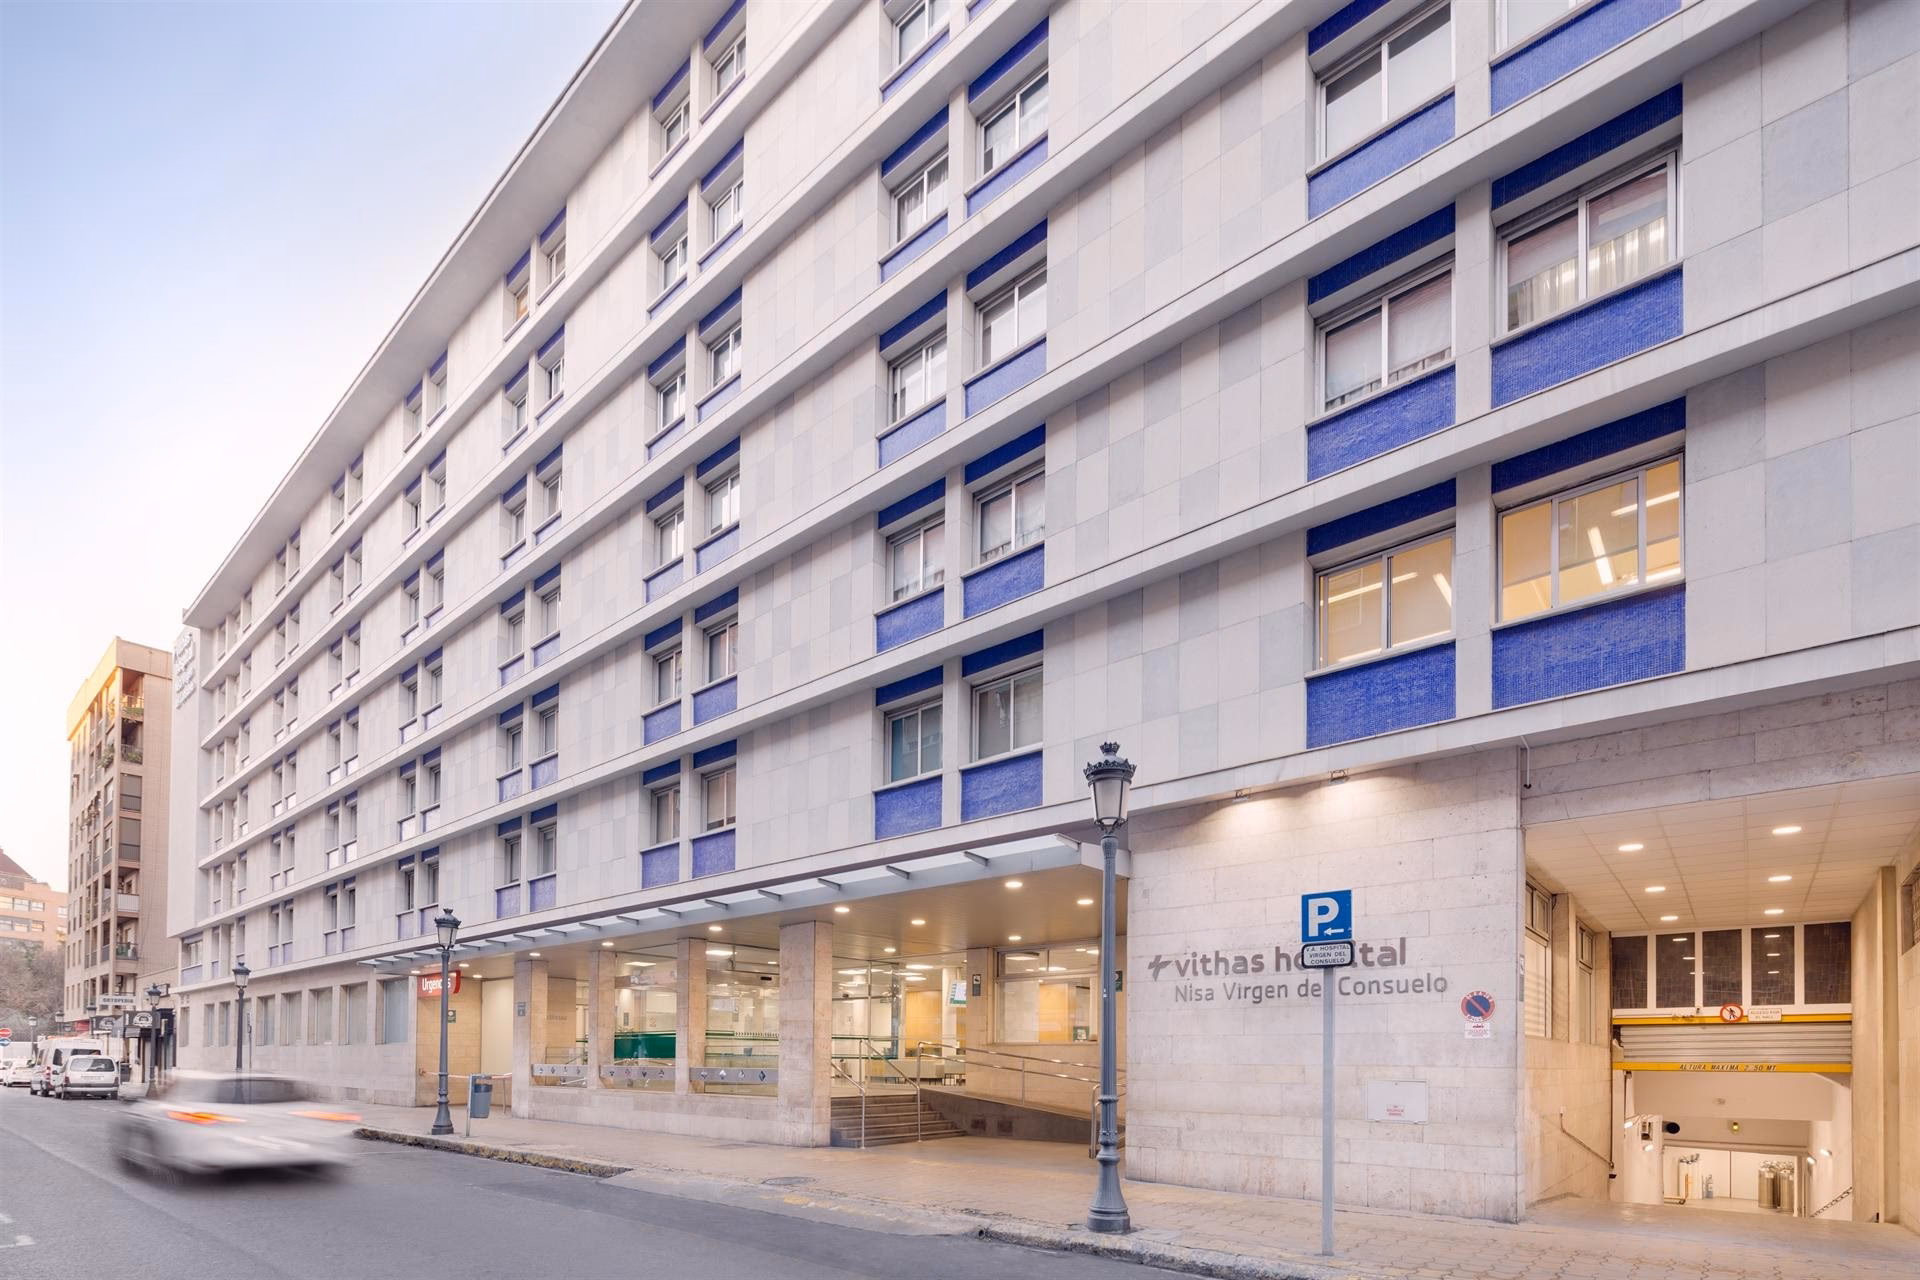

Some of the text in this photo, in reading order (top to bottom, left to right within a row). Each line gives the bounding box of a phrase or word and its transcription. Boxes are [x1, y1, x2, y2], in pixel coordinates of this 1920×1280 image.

[1308, 897, 1339, 937] P
[1175, 937, 1406, 977] vithas hotal
[1175, 973, 1447, 1004] Nisa Virgen de Consuelo
